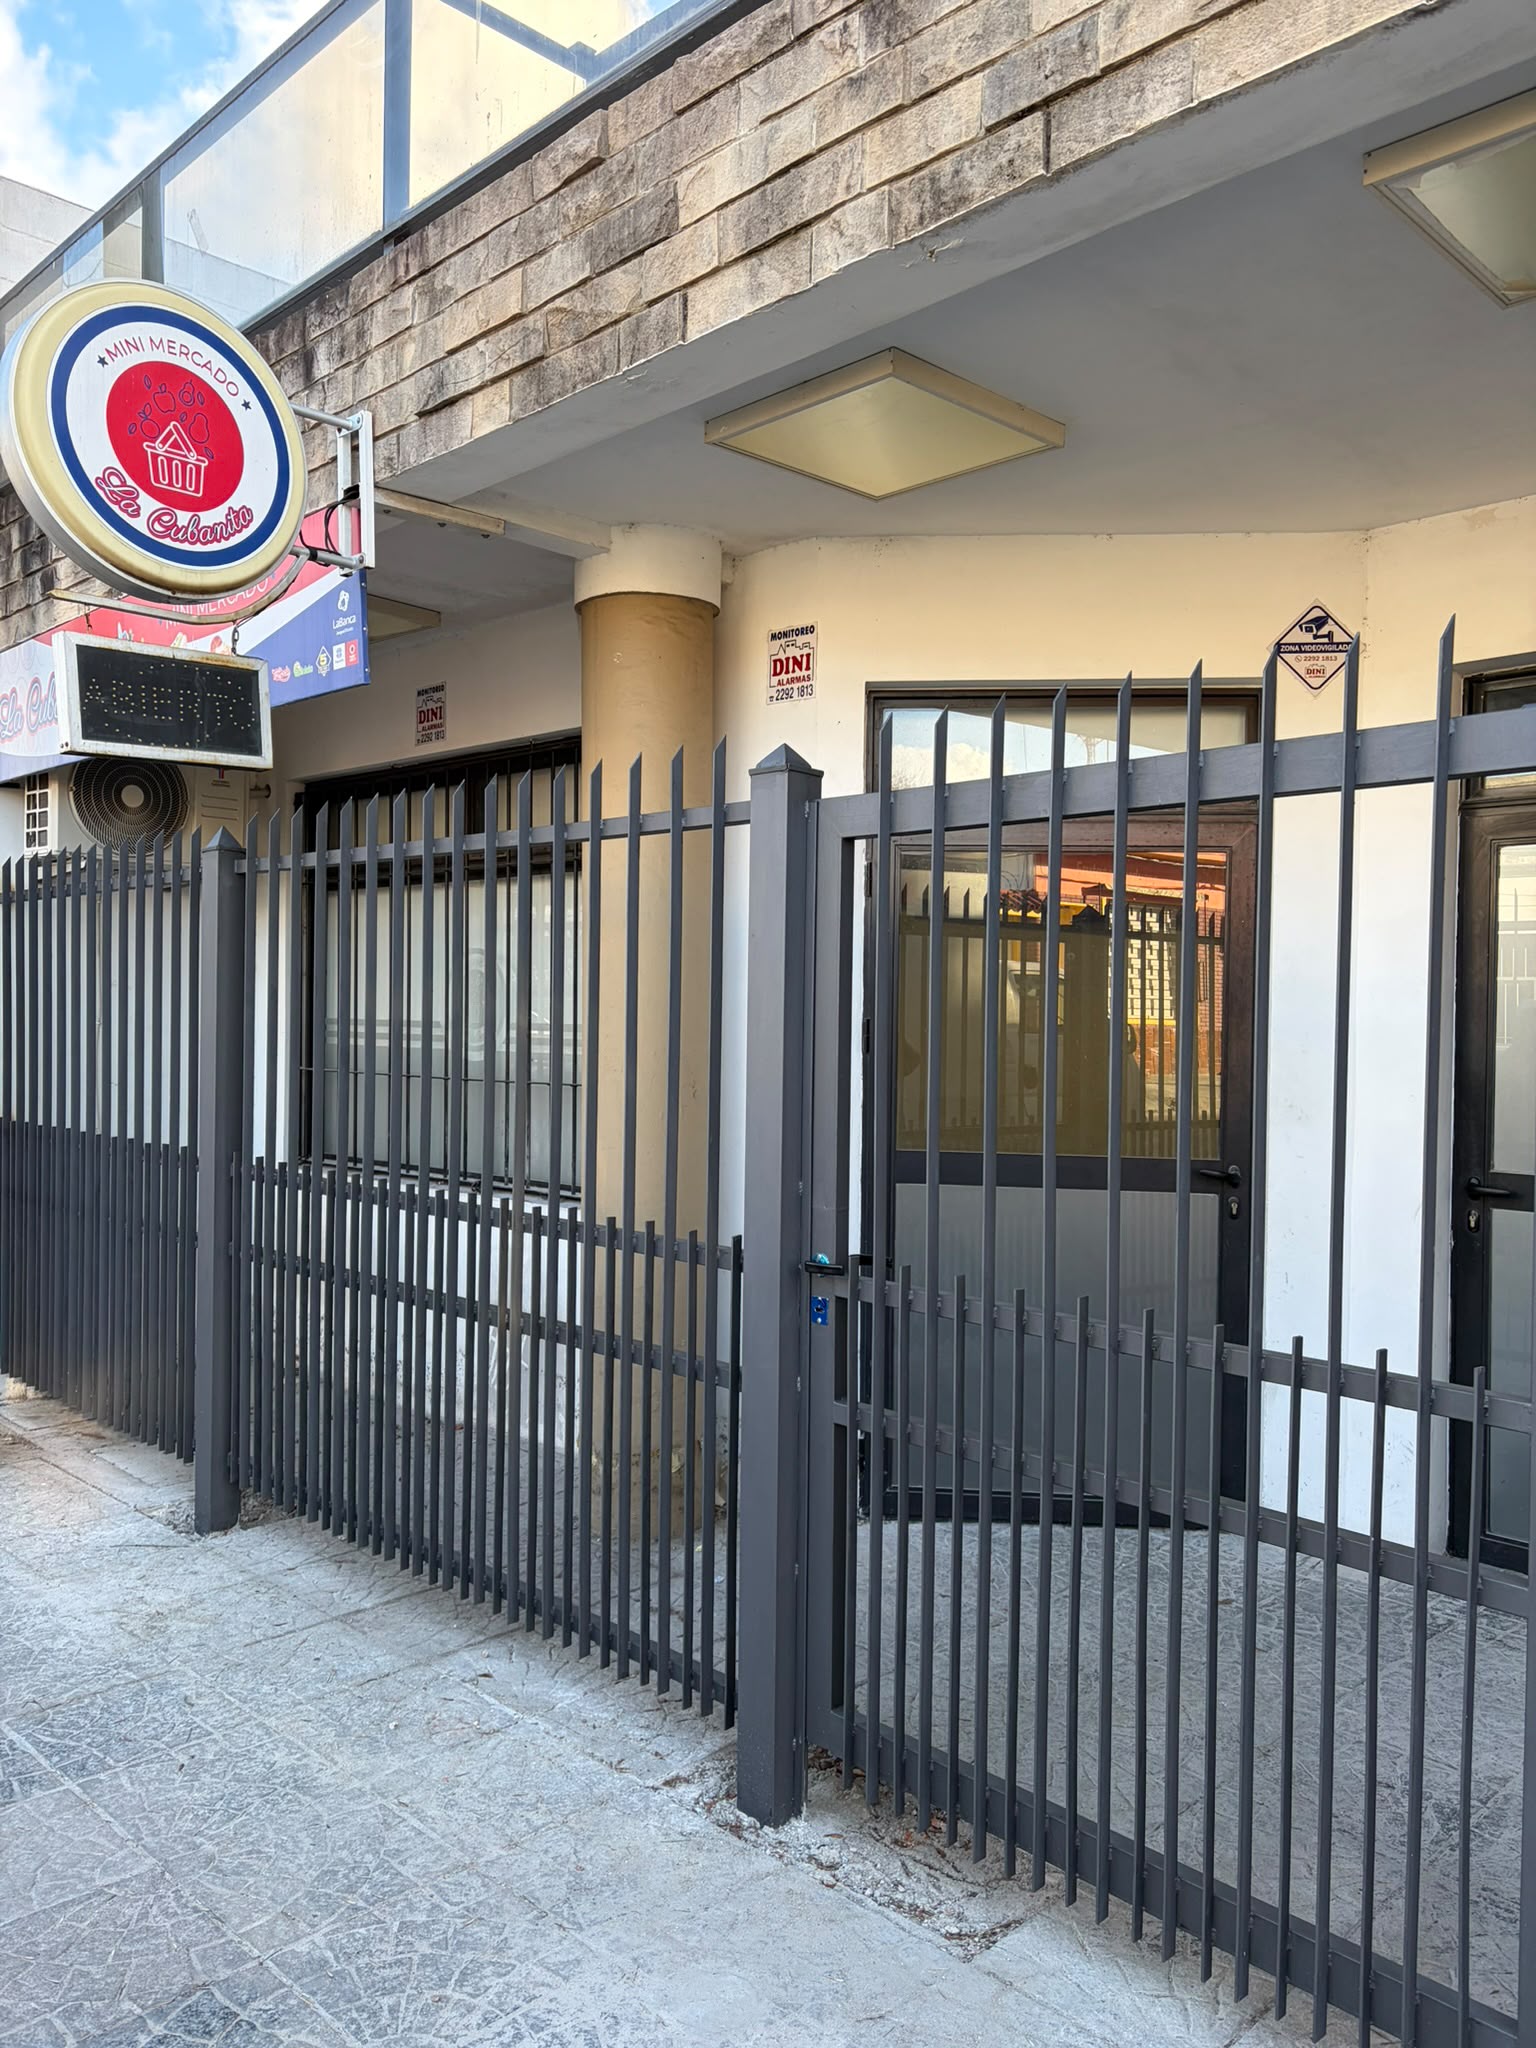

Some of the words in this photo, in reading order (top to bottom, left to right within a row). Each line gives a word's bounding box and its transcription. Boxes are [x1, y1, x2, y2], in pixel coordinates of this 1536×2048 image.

[104, 335, 145, 363] MINI
[149, 335, 239, 397] MERCADO
[95, 466, 141, 518] La
[146, 505, 254, 546] Cubanita
[770, 624, 815, 642] MONITOREO
[1280, 644, 1300, 652] ZONA
[772, 653, 811, 677] DINI
[777, 674, 811, 687] ALARMAS
[417, 685, 444, 697] MONITOREO
[775, 687, 794, 701] 2292
[797, 684, 814, 698] 1813
[82, 676, 257, 730] ABIERTO
[418, 705, 443, 725] DINI
